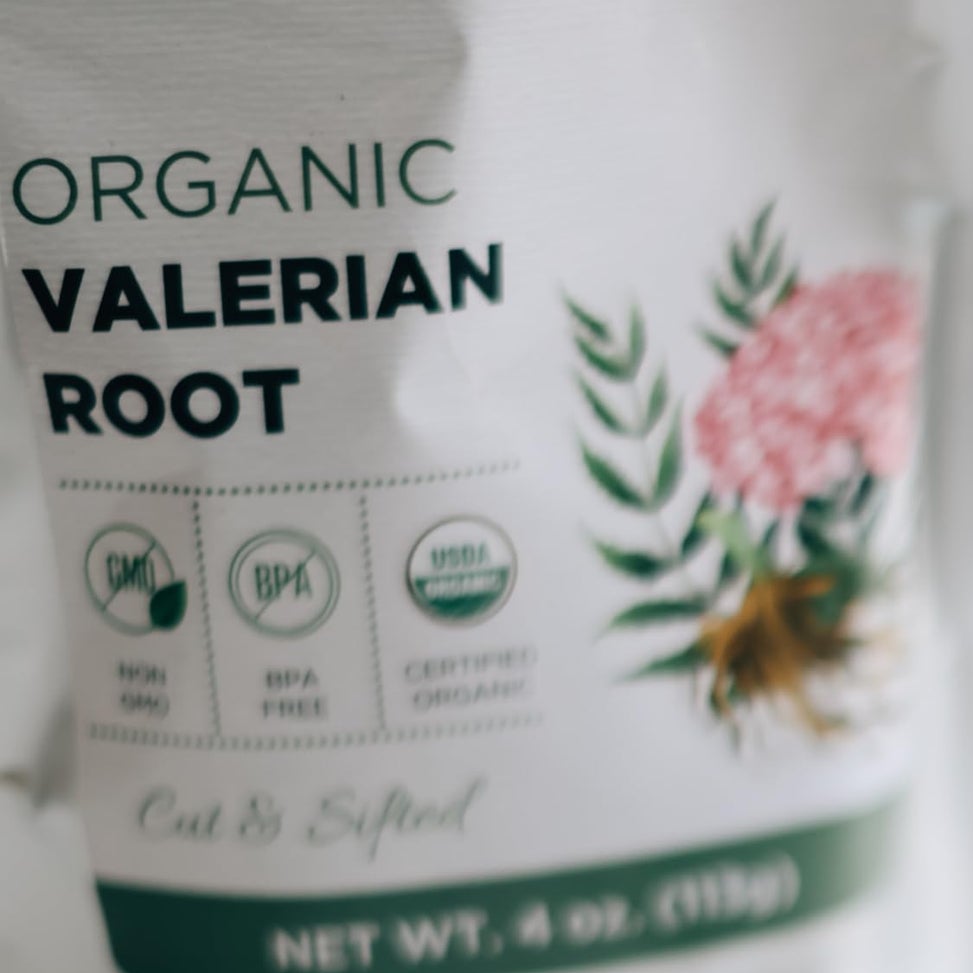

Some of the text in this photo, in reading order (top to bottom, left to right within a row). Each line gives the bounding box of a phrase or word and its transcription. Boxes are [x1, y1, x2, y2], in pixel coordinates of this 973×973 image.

[12, 138, 457, 225] ORGANIC
[22, 242, 503, 333] VALERIAN
[43, 368, 300, 439] ROOT
[106, 552, 156, 595] GMO
[255, 562, 313, 601] BPA
[430, 542, 491, 570] USDA
[266, 667, 319, 690] BPA
[262, 697, 327, 720] FREE
[135, 773, 486, 864] Cut & Sifted
[272, 920, 379, 973] NET
[516, 901, 551, 948] 4
